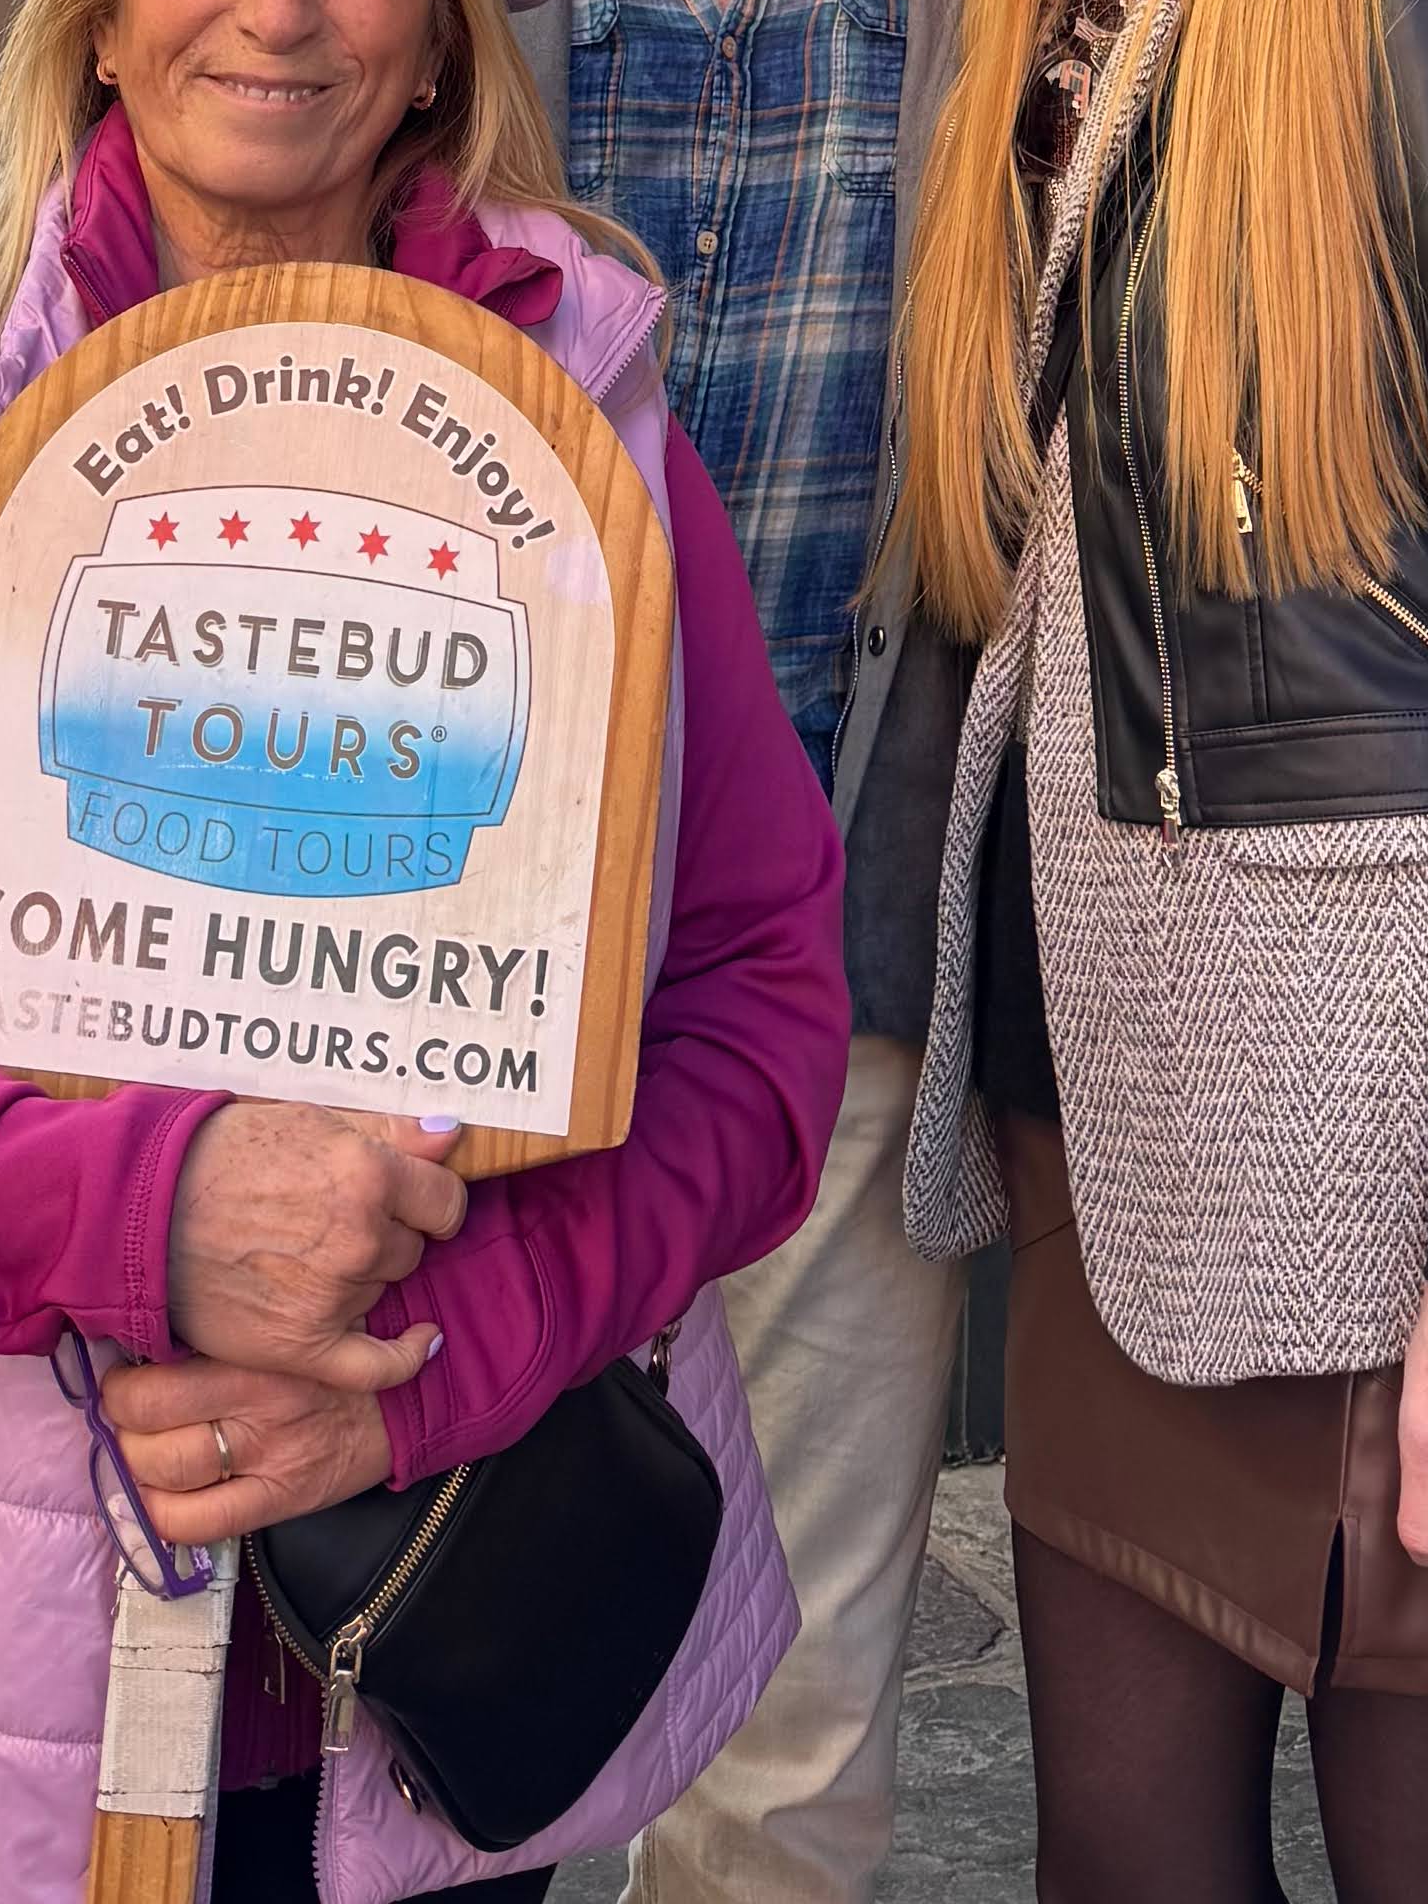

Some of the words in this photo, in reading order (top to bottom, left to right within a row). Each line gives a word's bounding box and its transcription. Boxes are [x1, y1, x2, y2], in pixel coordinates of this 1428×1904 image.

[72, 383, 193, 497] Eat!
[204, 354, 396, 417] Drink!
[400, 382, 557, 550] Enjoy!
[96, 598, 490, 691] TASTEBUD
[75, 790, 239, 867] FOOD
[261, 823, 455, 880] TOURS
[201, 912, 552, 1019] HUNGRY!
